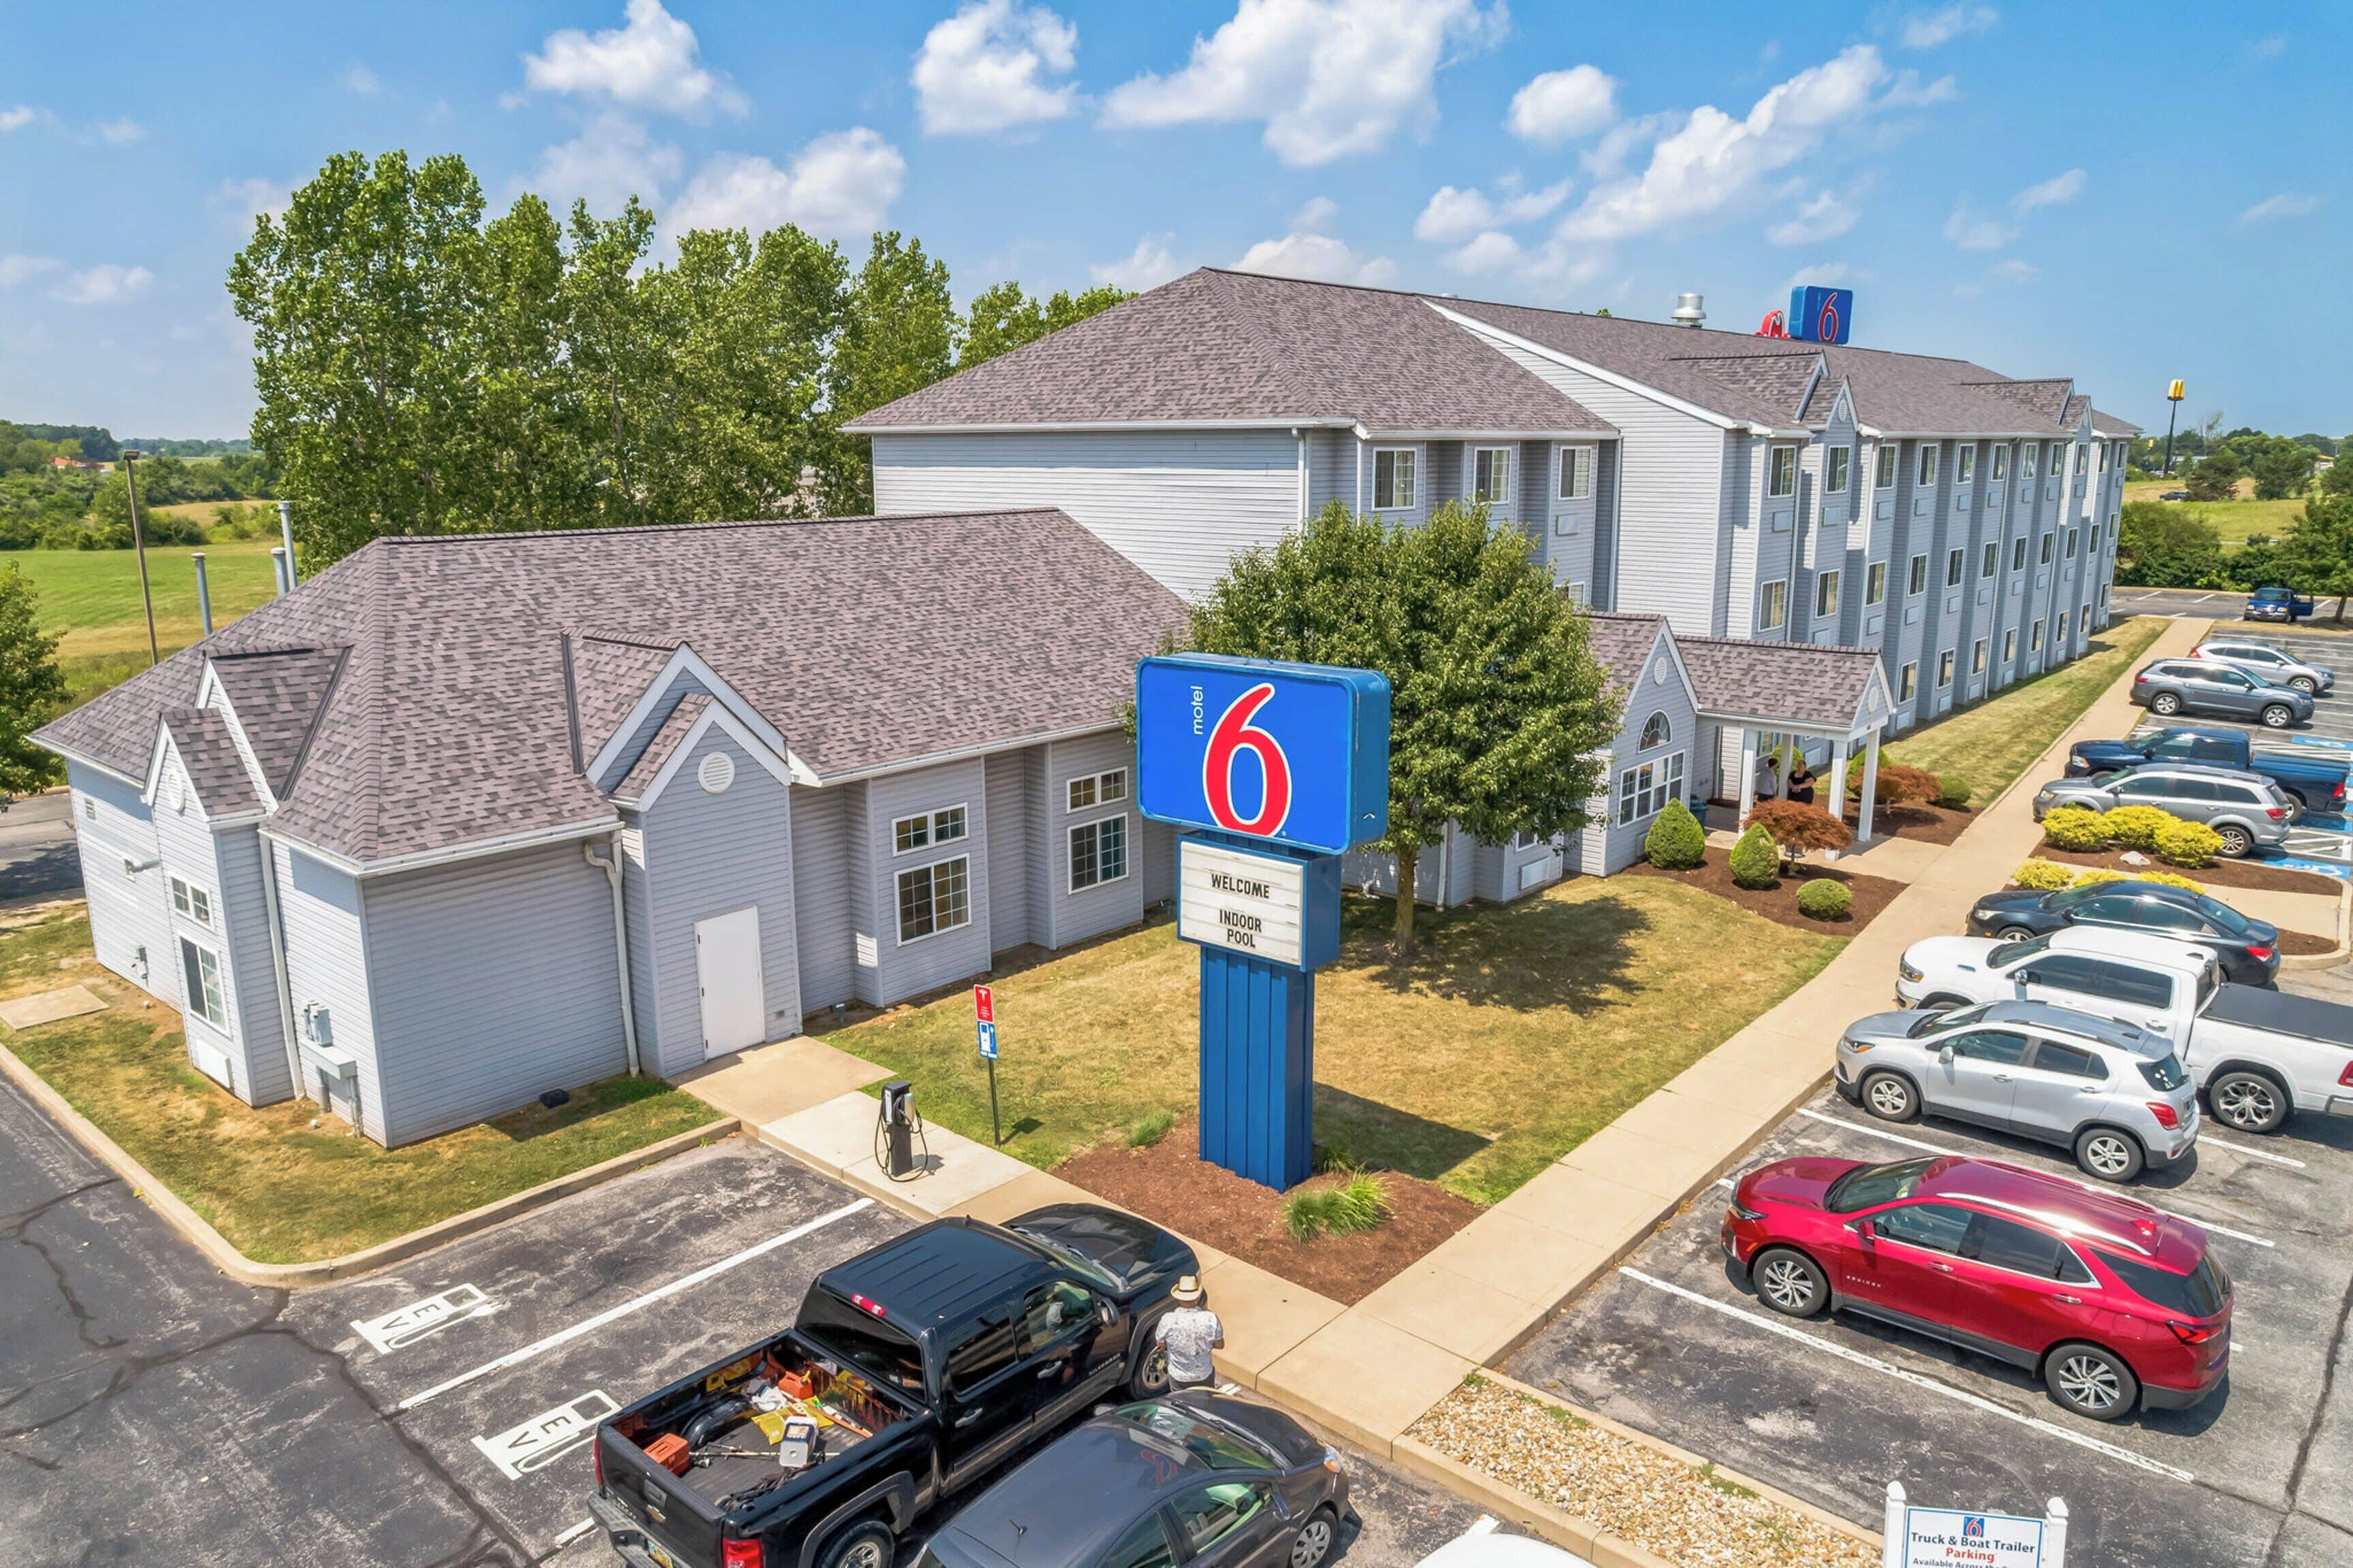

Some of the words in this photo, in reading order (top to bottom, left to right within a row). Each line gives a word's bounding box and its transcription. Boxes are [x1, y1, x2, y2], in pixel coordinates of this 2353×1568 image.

[1818, 292, 1838, 342] 6
[1190, 686, 1204, 735] motel
[1202, 682, 1292, 837] 6
[1211, 874, 1269, 899] WELCOME
[1220, 909, 1262, 932] INDOOR
[1228, 928, 1255, 948] POOL
[1966, 1518, 1983, 1537] 6
[1911, 1533, 1945, 1545] Truck
[1948, 1535, 1957, 1546] &
[1961, 1537, 1990, 1549] Boat
[1994, 1540, 2036, 1553] Trailer
[1913, 1558, 1953, 1567] Available
[1946, 1548, 1995, 1563] Parking
